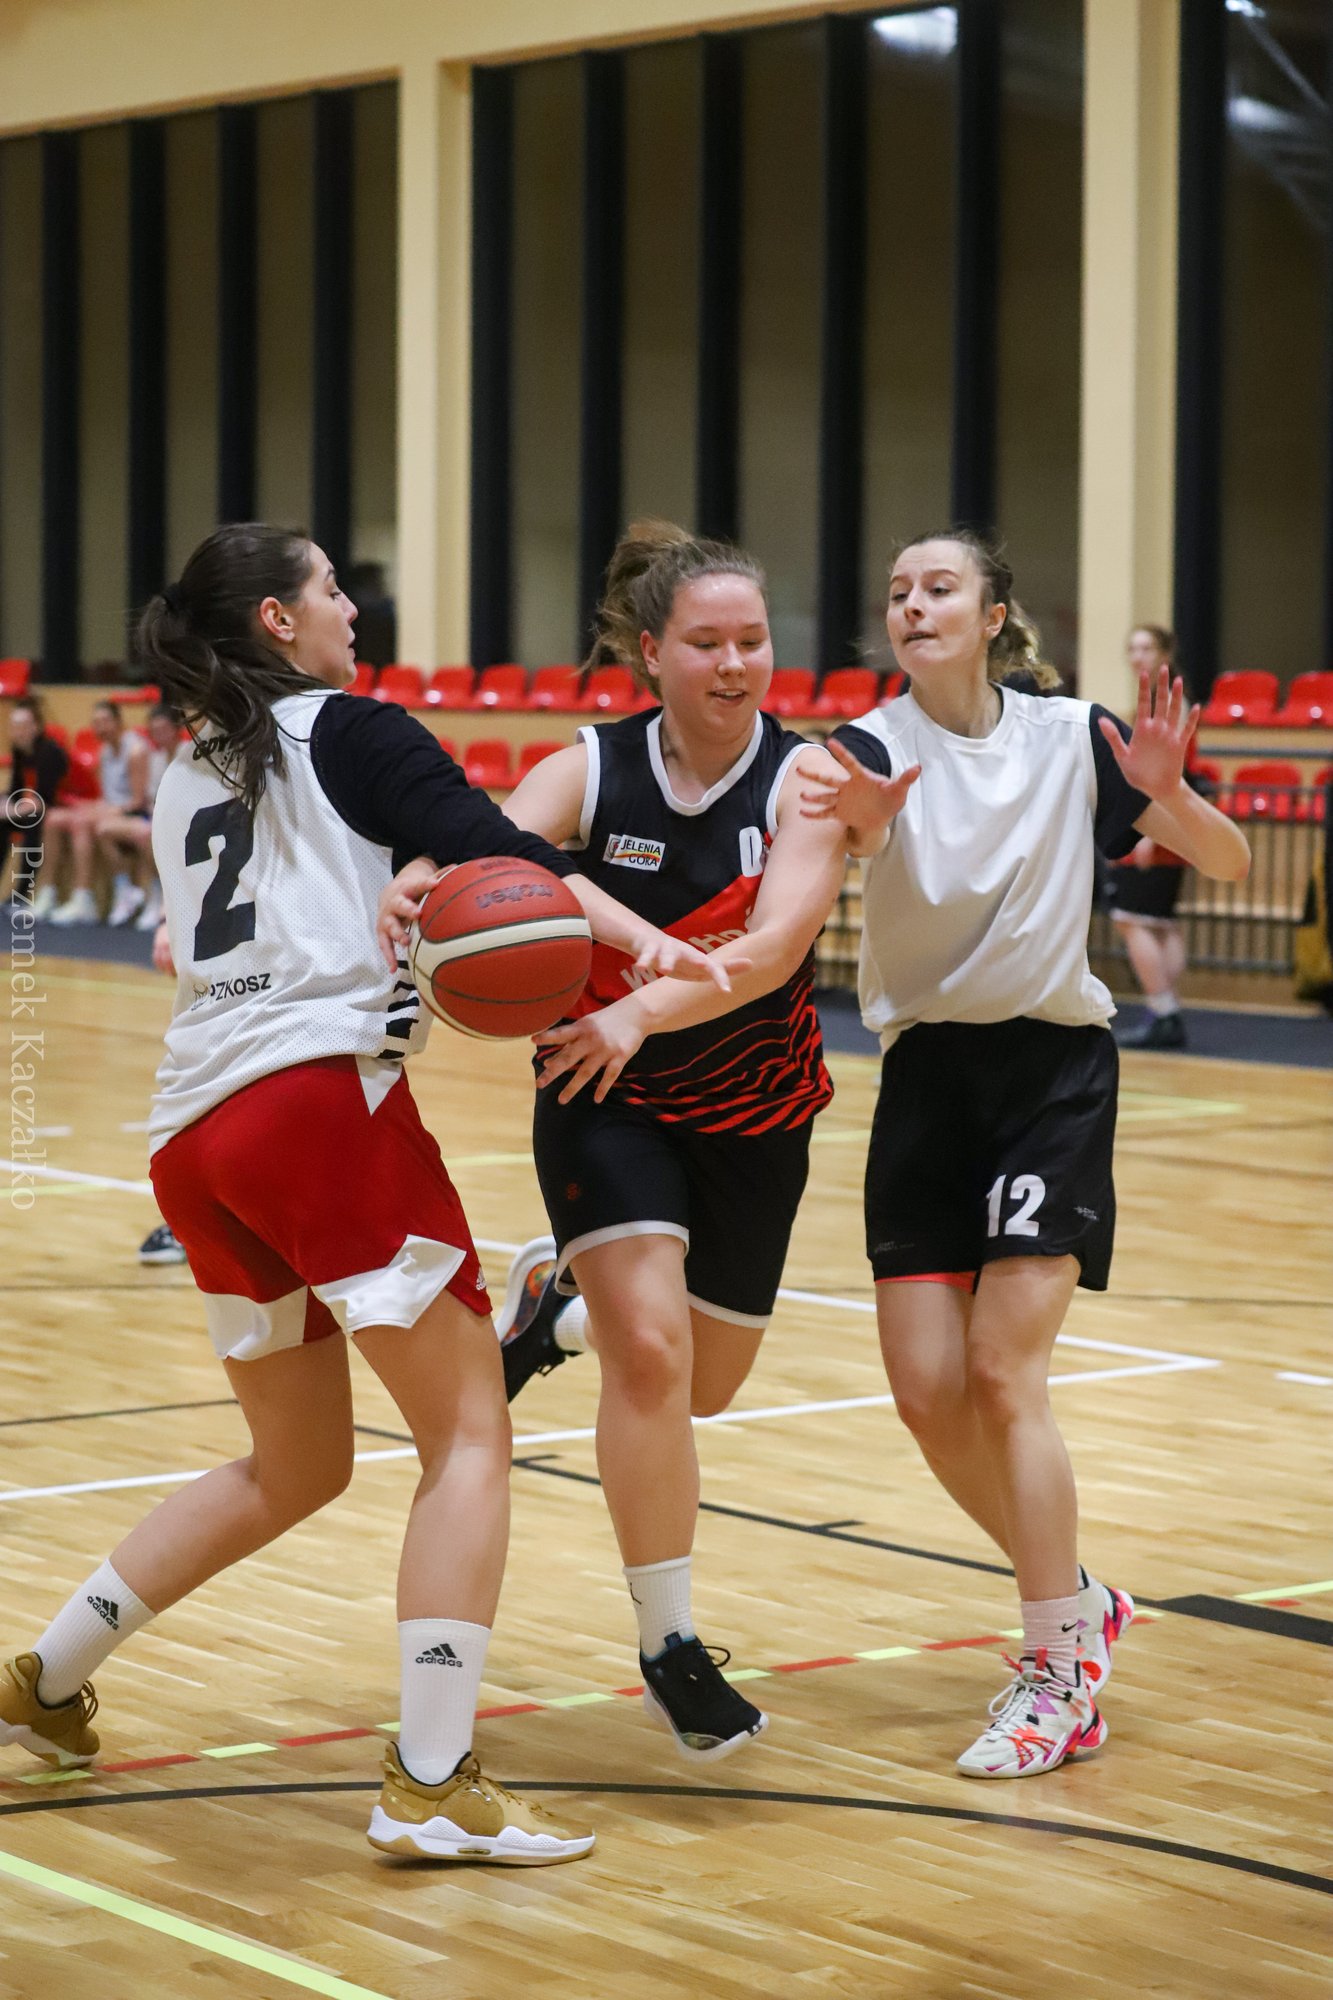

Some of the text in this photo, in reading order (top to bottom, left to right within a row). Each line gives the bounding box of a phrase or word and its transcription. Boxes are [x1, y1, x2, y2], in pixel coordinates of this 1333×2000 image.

[620, 839, 661, 856] JELENIA
[628, 853, 658, 867] GÓRA
[184, 797, 257, 962] 2
[985, 1174, 1047, 1238] 12
[87, 1595, 119, 1631] adidas
[415, 1655, 463, 1668] adidas
